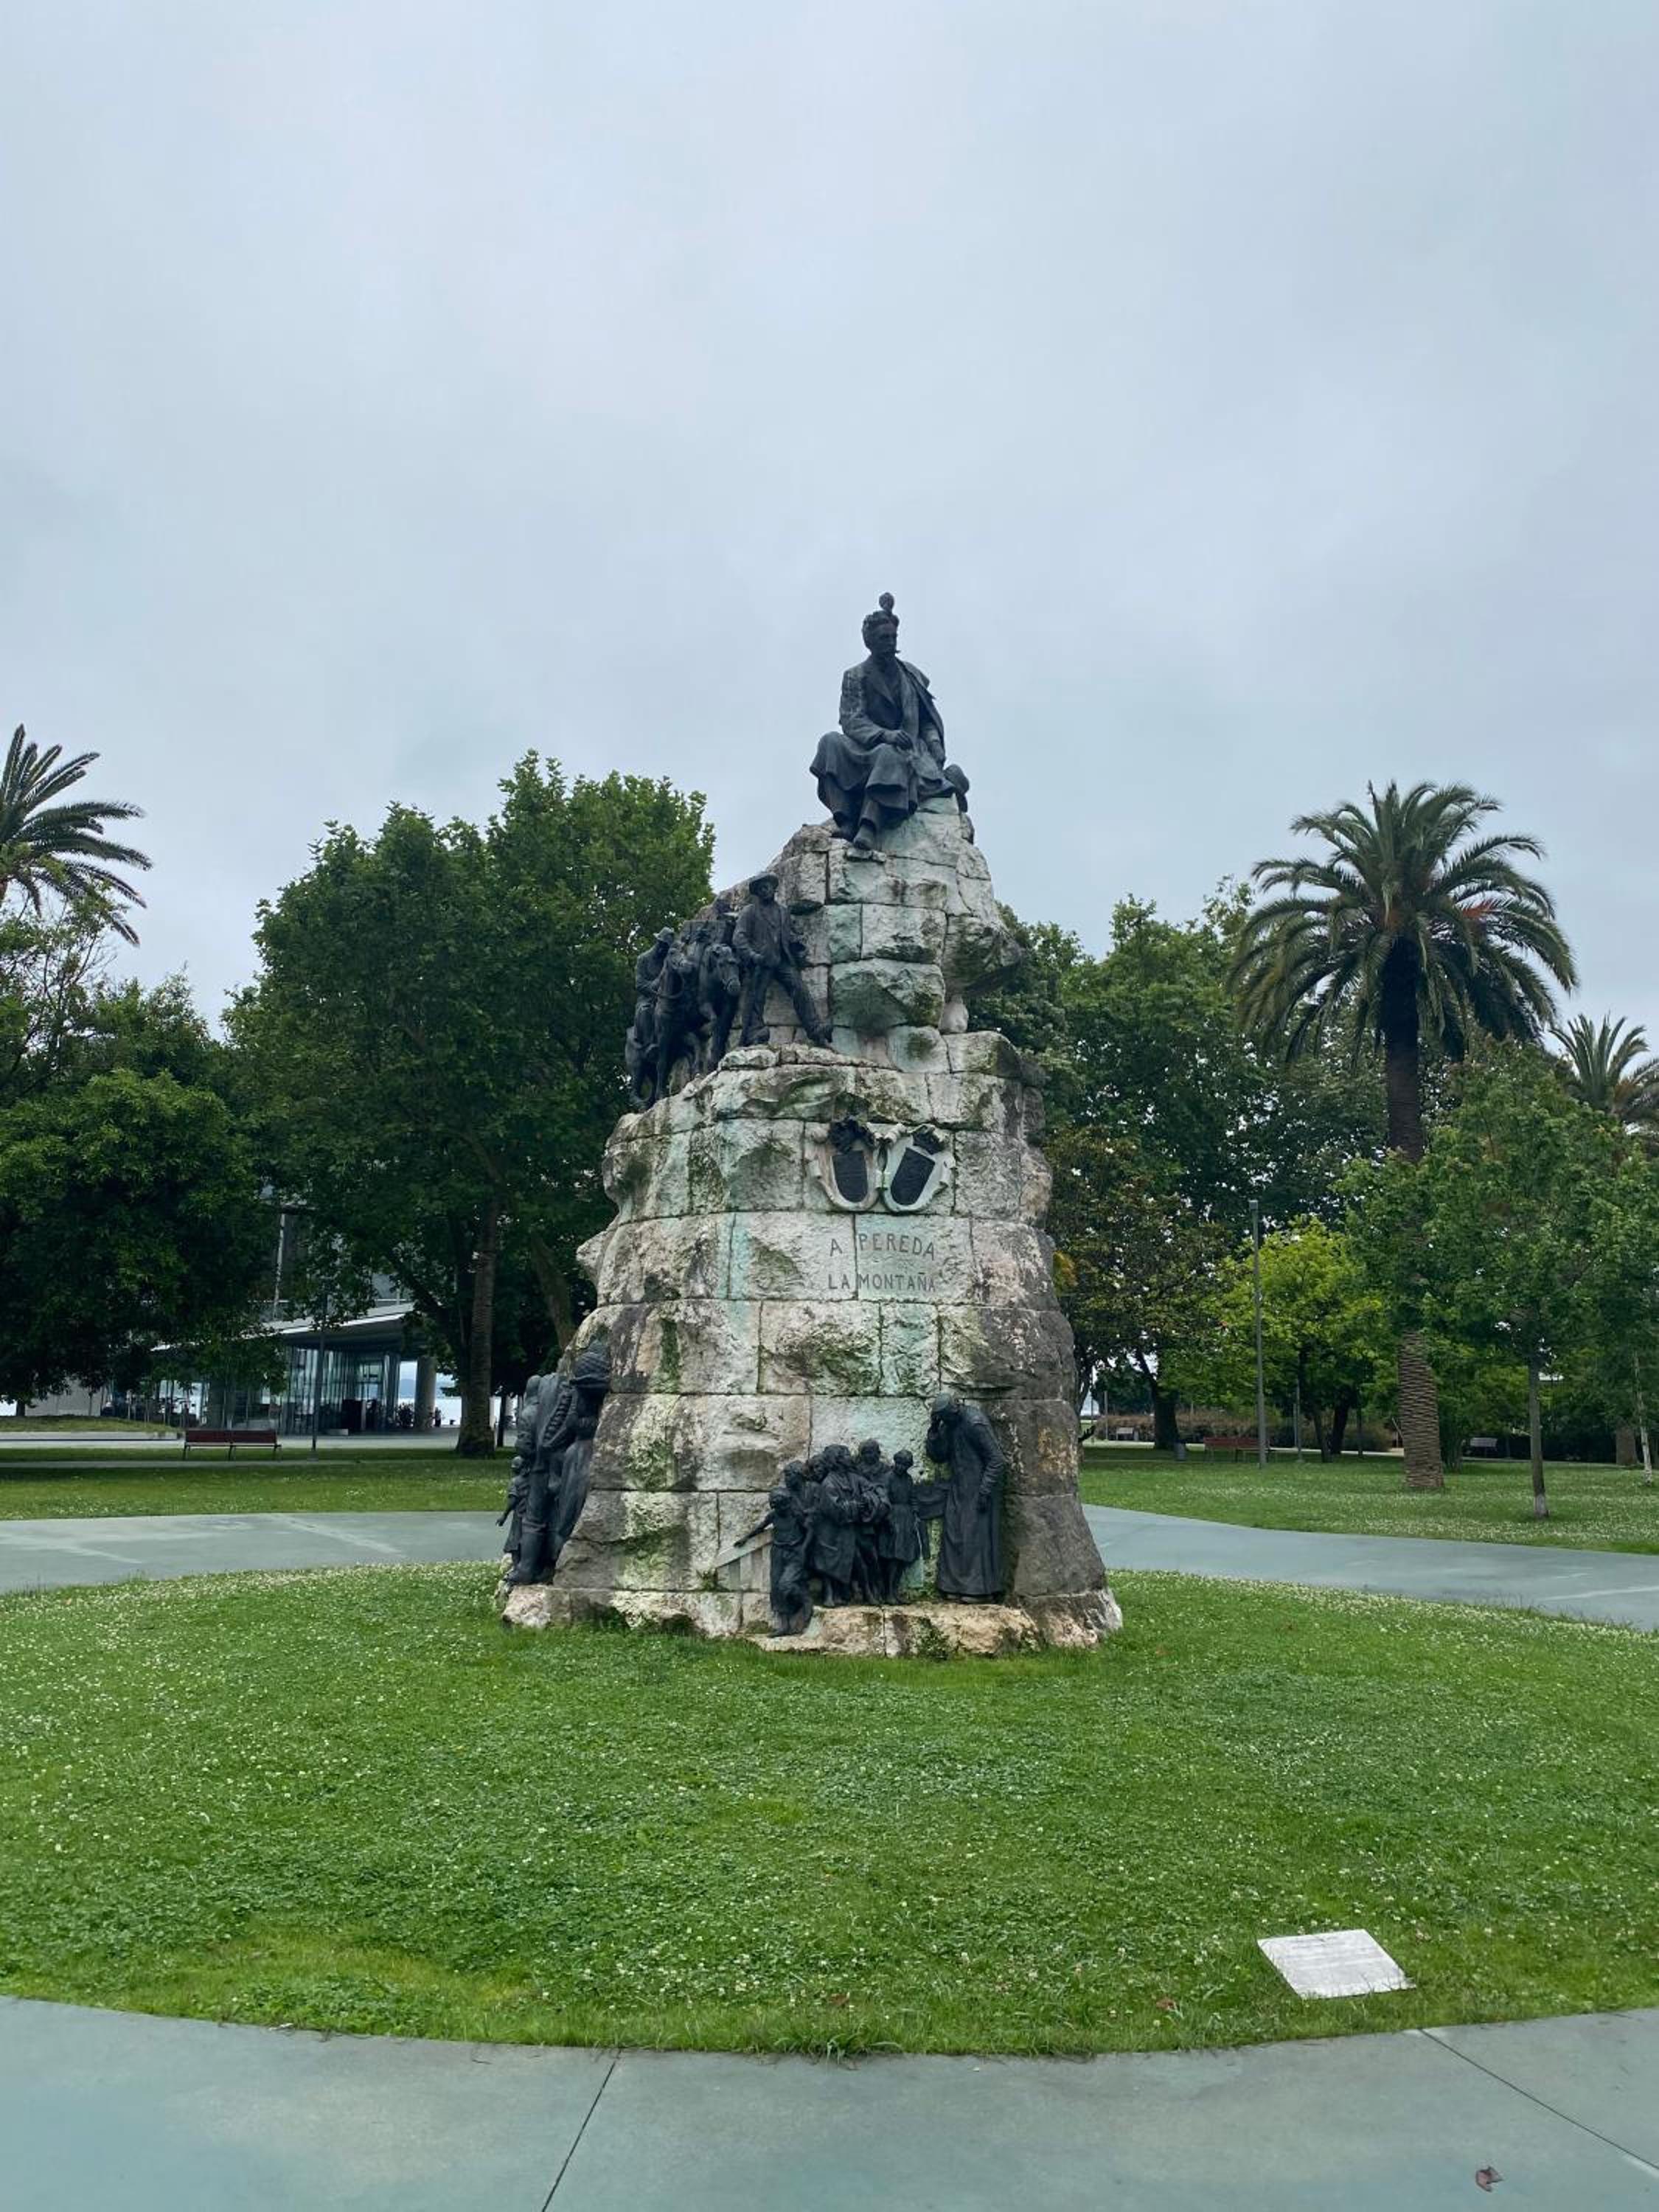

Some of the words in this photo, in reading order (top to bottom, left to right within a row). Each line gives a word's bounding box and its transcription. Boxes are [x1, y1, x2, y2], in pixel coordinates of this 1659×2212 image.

[830, 1238, 843, 1257] A
[858, 1233, 935, 1260] PEREDA
[828, 1274, 850, 1290] LA
[858, 1272, 936, 1292] MONTAÑA
